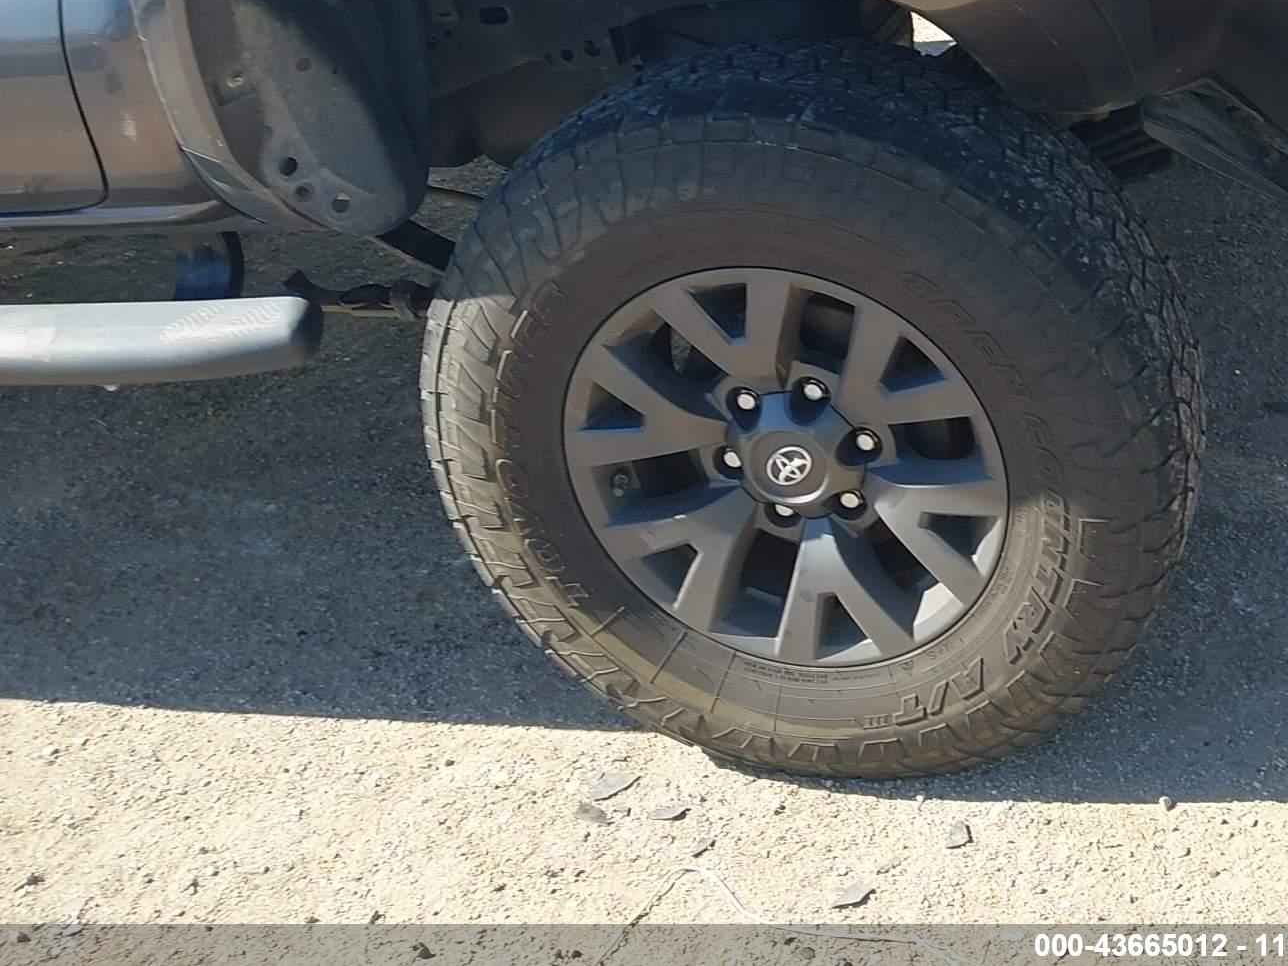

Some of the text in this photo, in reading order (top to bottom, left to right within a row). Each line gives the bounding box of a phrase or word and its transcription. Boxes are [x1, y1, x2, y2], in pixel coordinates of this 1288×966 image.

[898, 270, 1032, 400] OPEN
[1001, 412, 1070, 666] COUNTRY
[892, 656, 986, 727] A/T
